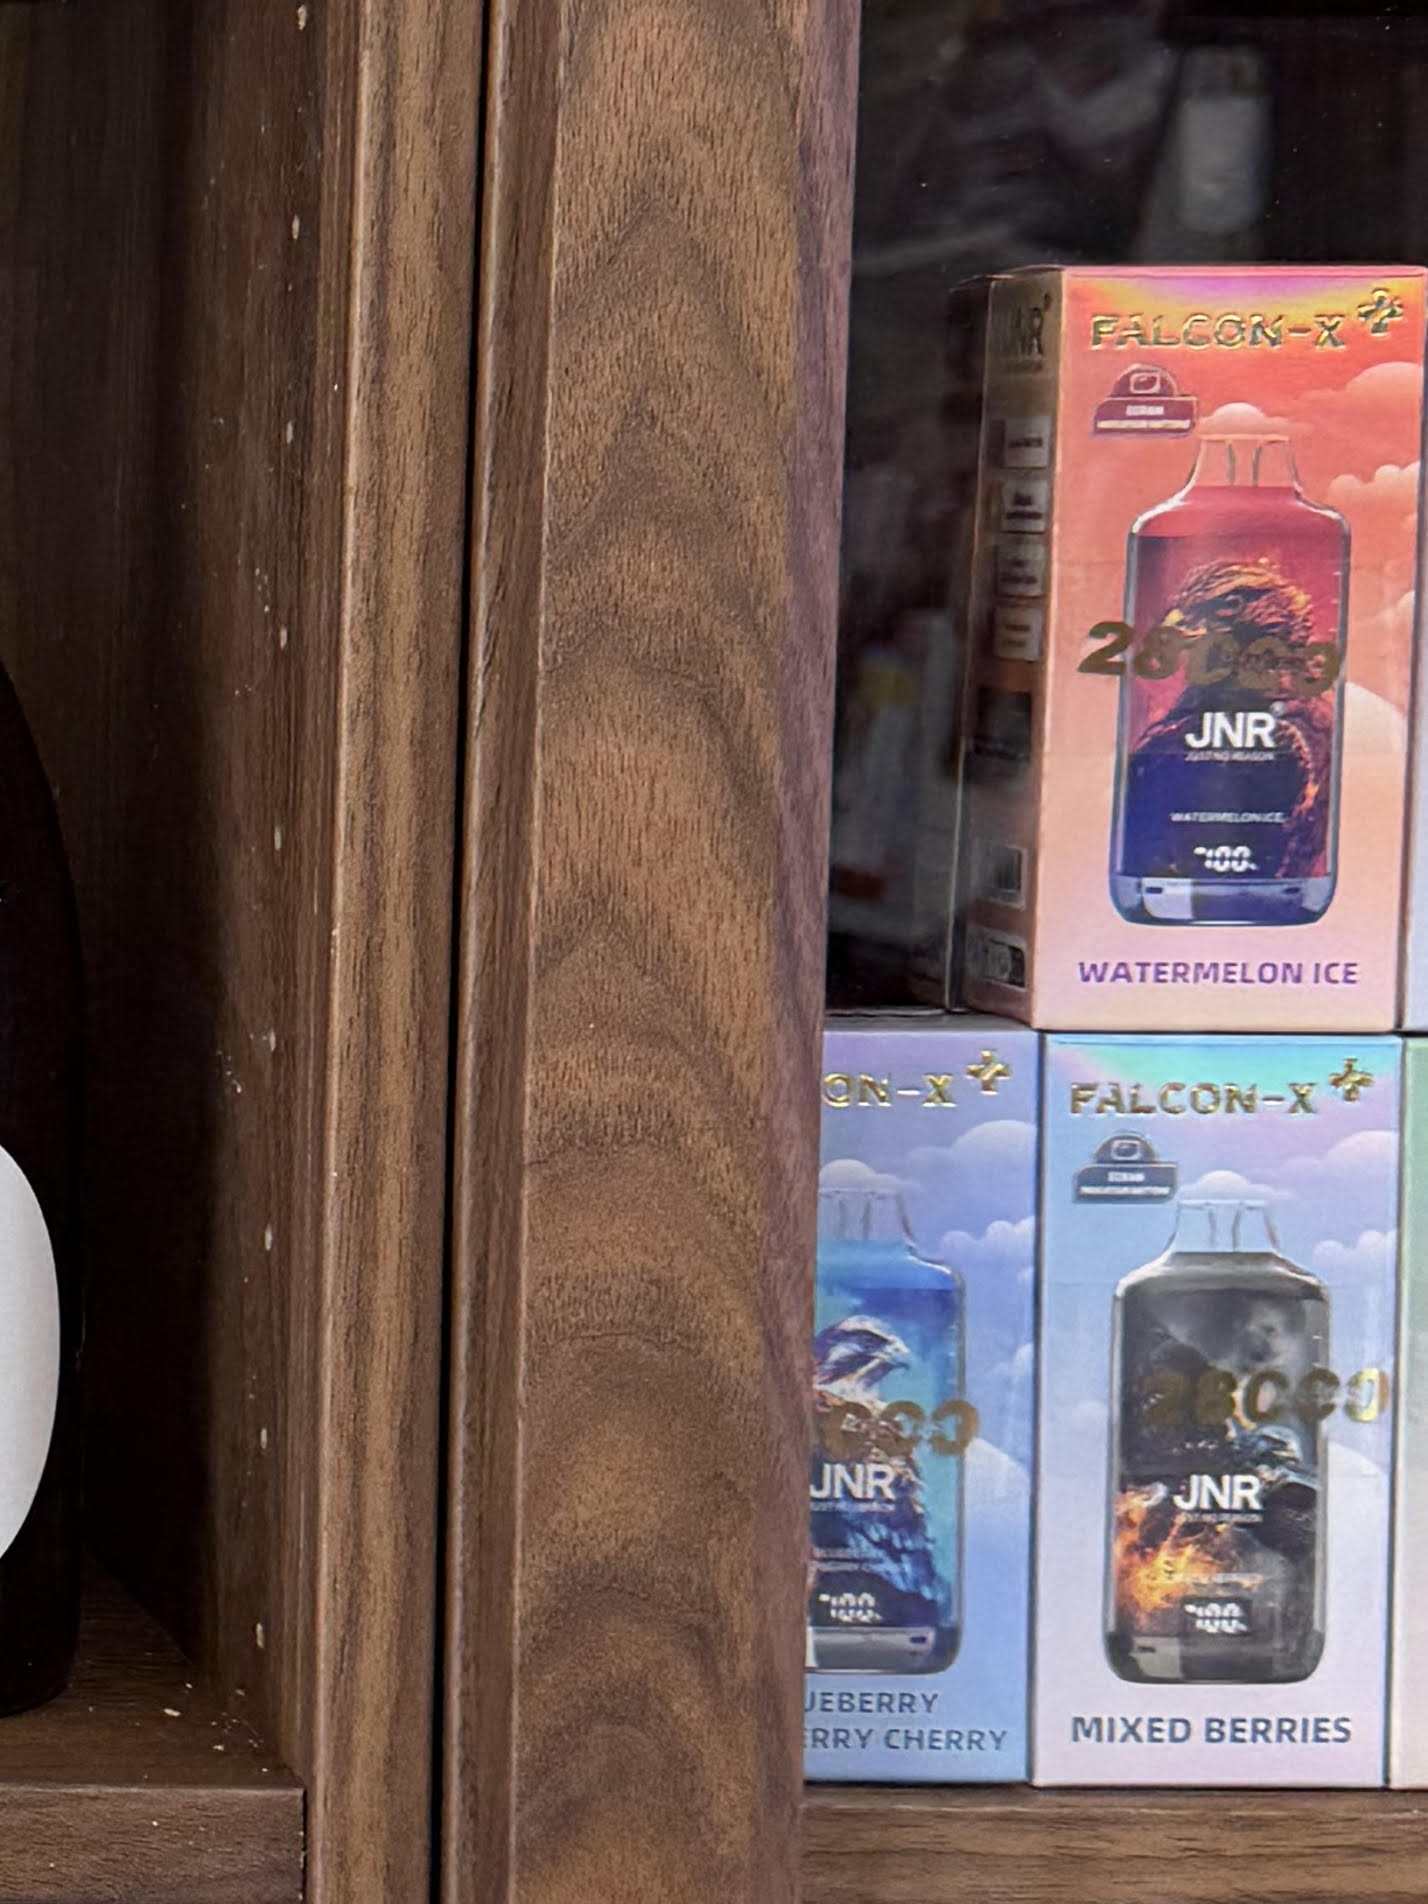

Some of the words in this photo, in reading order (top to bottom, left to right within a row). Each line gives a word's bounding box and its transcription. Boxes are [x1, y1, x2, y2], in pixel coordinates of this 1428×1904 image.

[1185, 711, 1276, 748] JNR
[1079, 960, 1305, 985] WATERMELON
[1310, 962, 1357, 985] ICE
[1175, 1474, 1262, 1512] JNR
[884, 1727, 1007, 1752] CHERRY
[1072, 1717, 1190, 1744] MIXED
[1205, 1717, 1352, 1744] BERRIES
